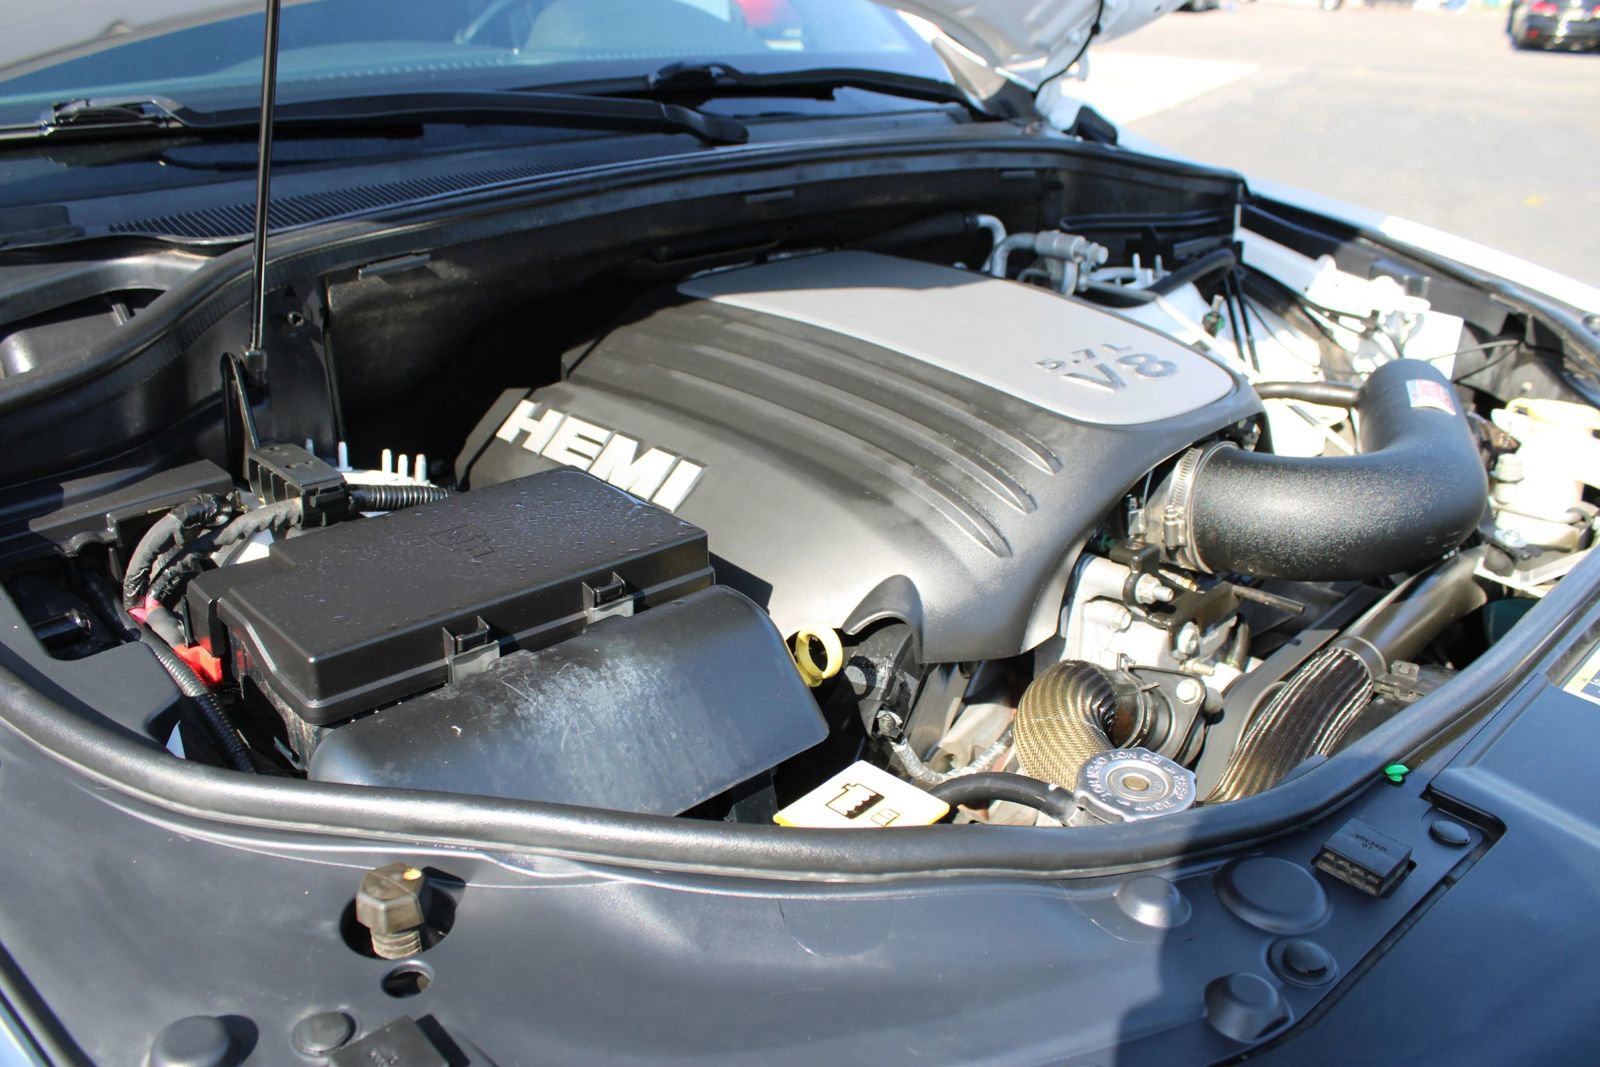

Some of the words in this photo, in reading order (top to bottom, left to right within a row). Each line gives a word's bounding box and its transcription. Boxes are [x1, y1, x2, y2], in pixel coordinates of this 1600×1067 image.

[1035, 343, 1133, 371] 5.7L
[1061, 353, 1178, 393] V8
[496, 399, 704, 513] HEMI
